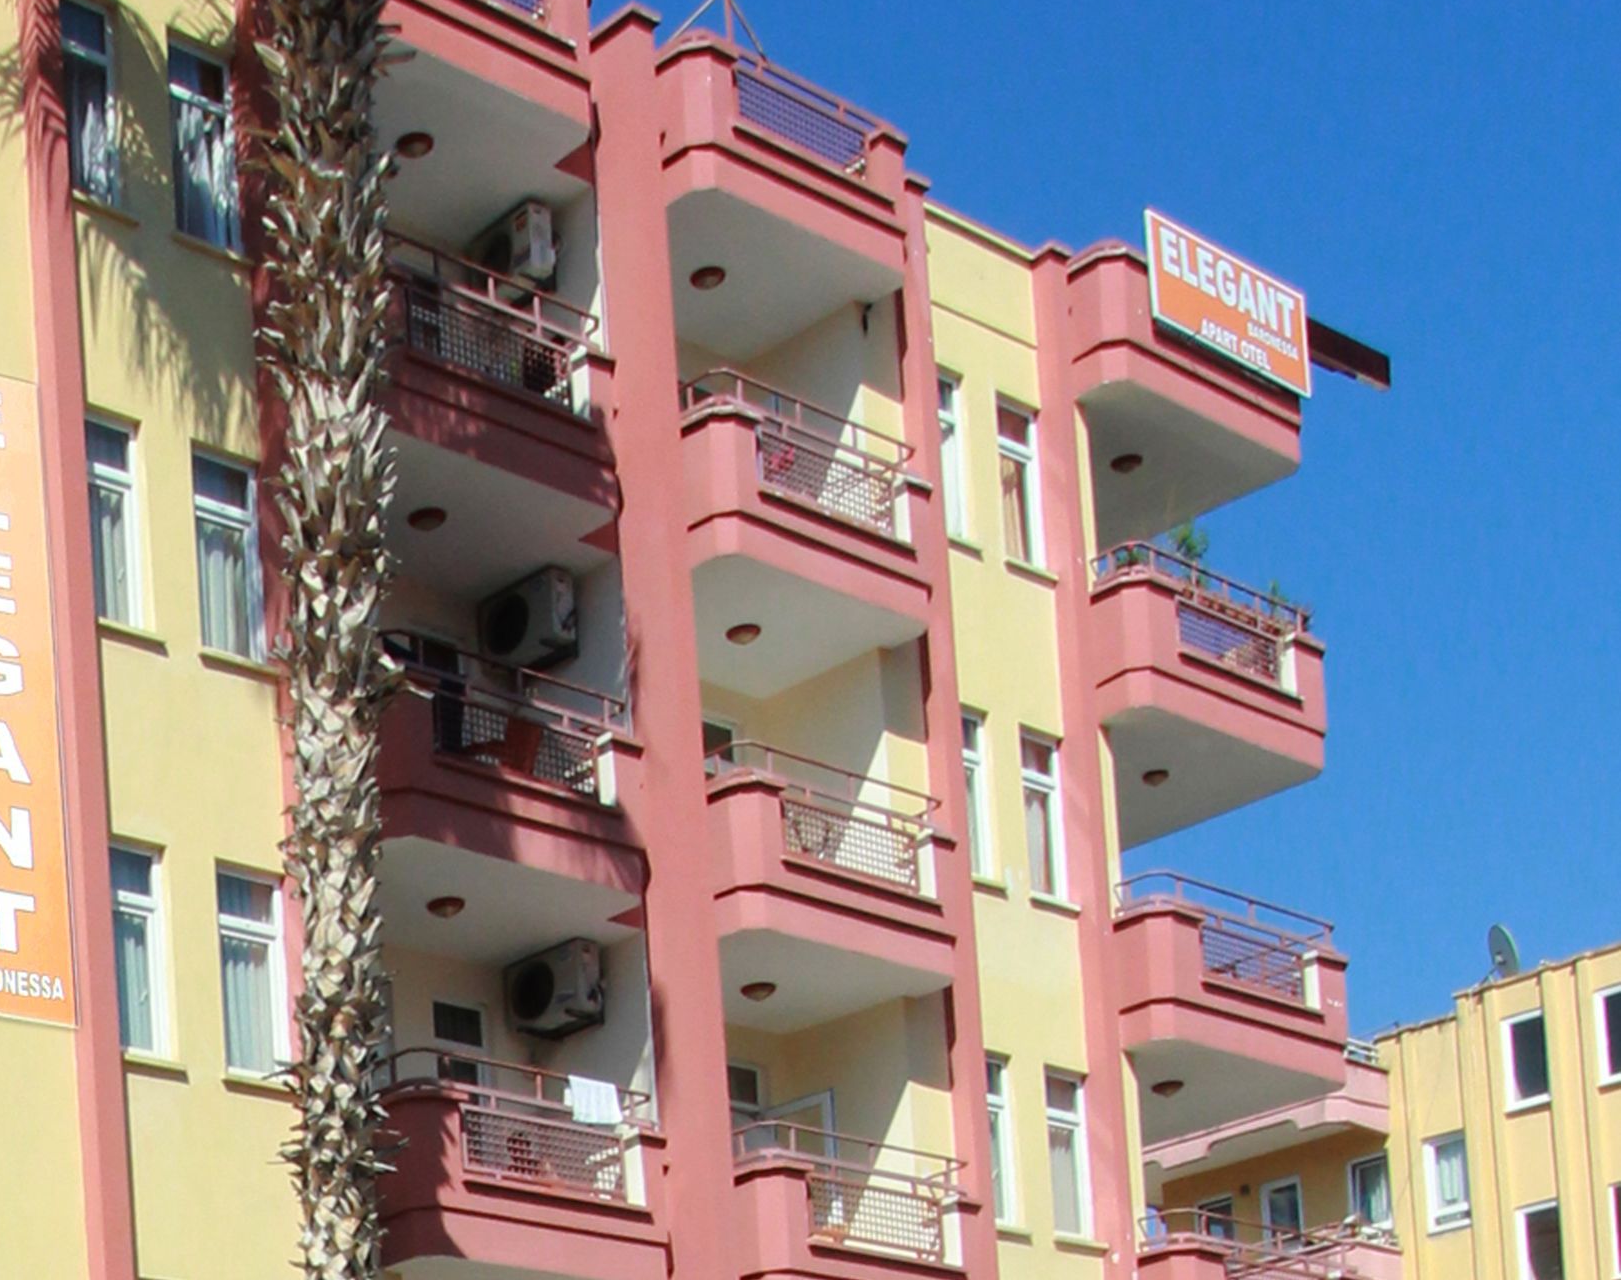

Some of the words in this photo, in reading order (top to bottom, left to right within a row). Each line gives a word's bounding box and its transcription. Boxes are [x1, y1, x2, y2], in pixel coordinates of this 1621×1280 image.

[1159, 226, 1294, 338] ELEGANT
[1201, 318, 1237, 353] APART
[1241, 340, 1271, 370] OTEL
